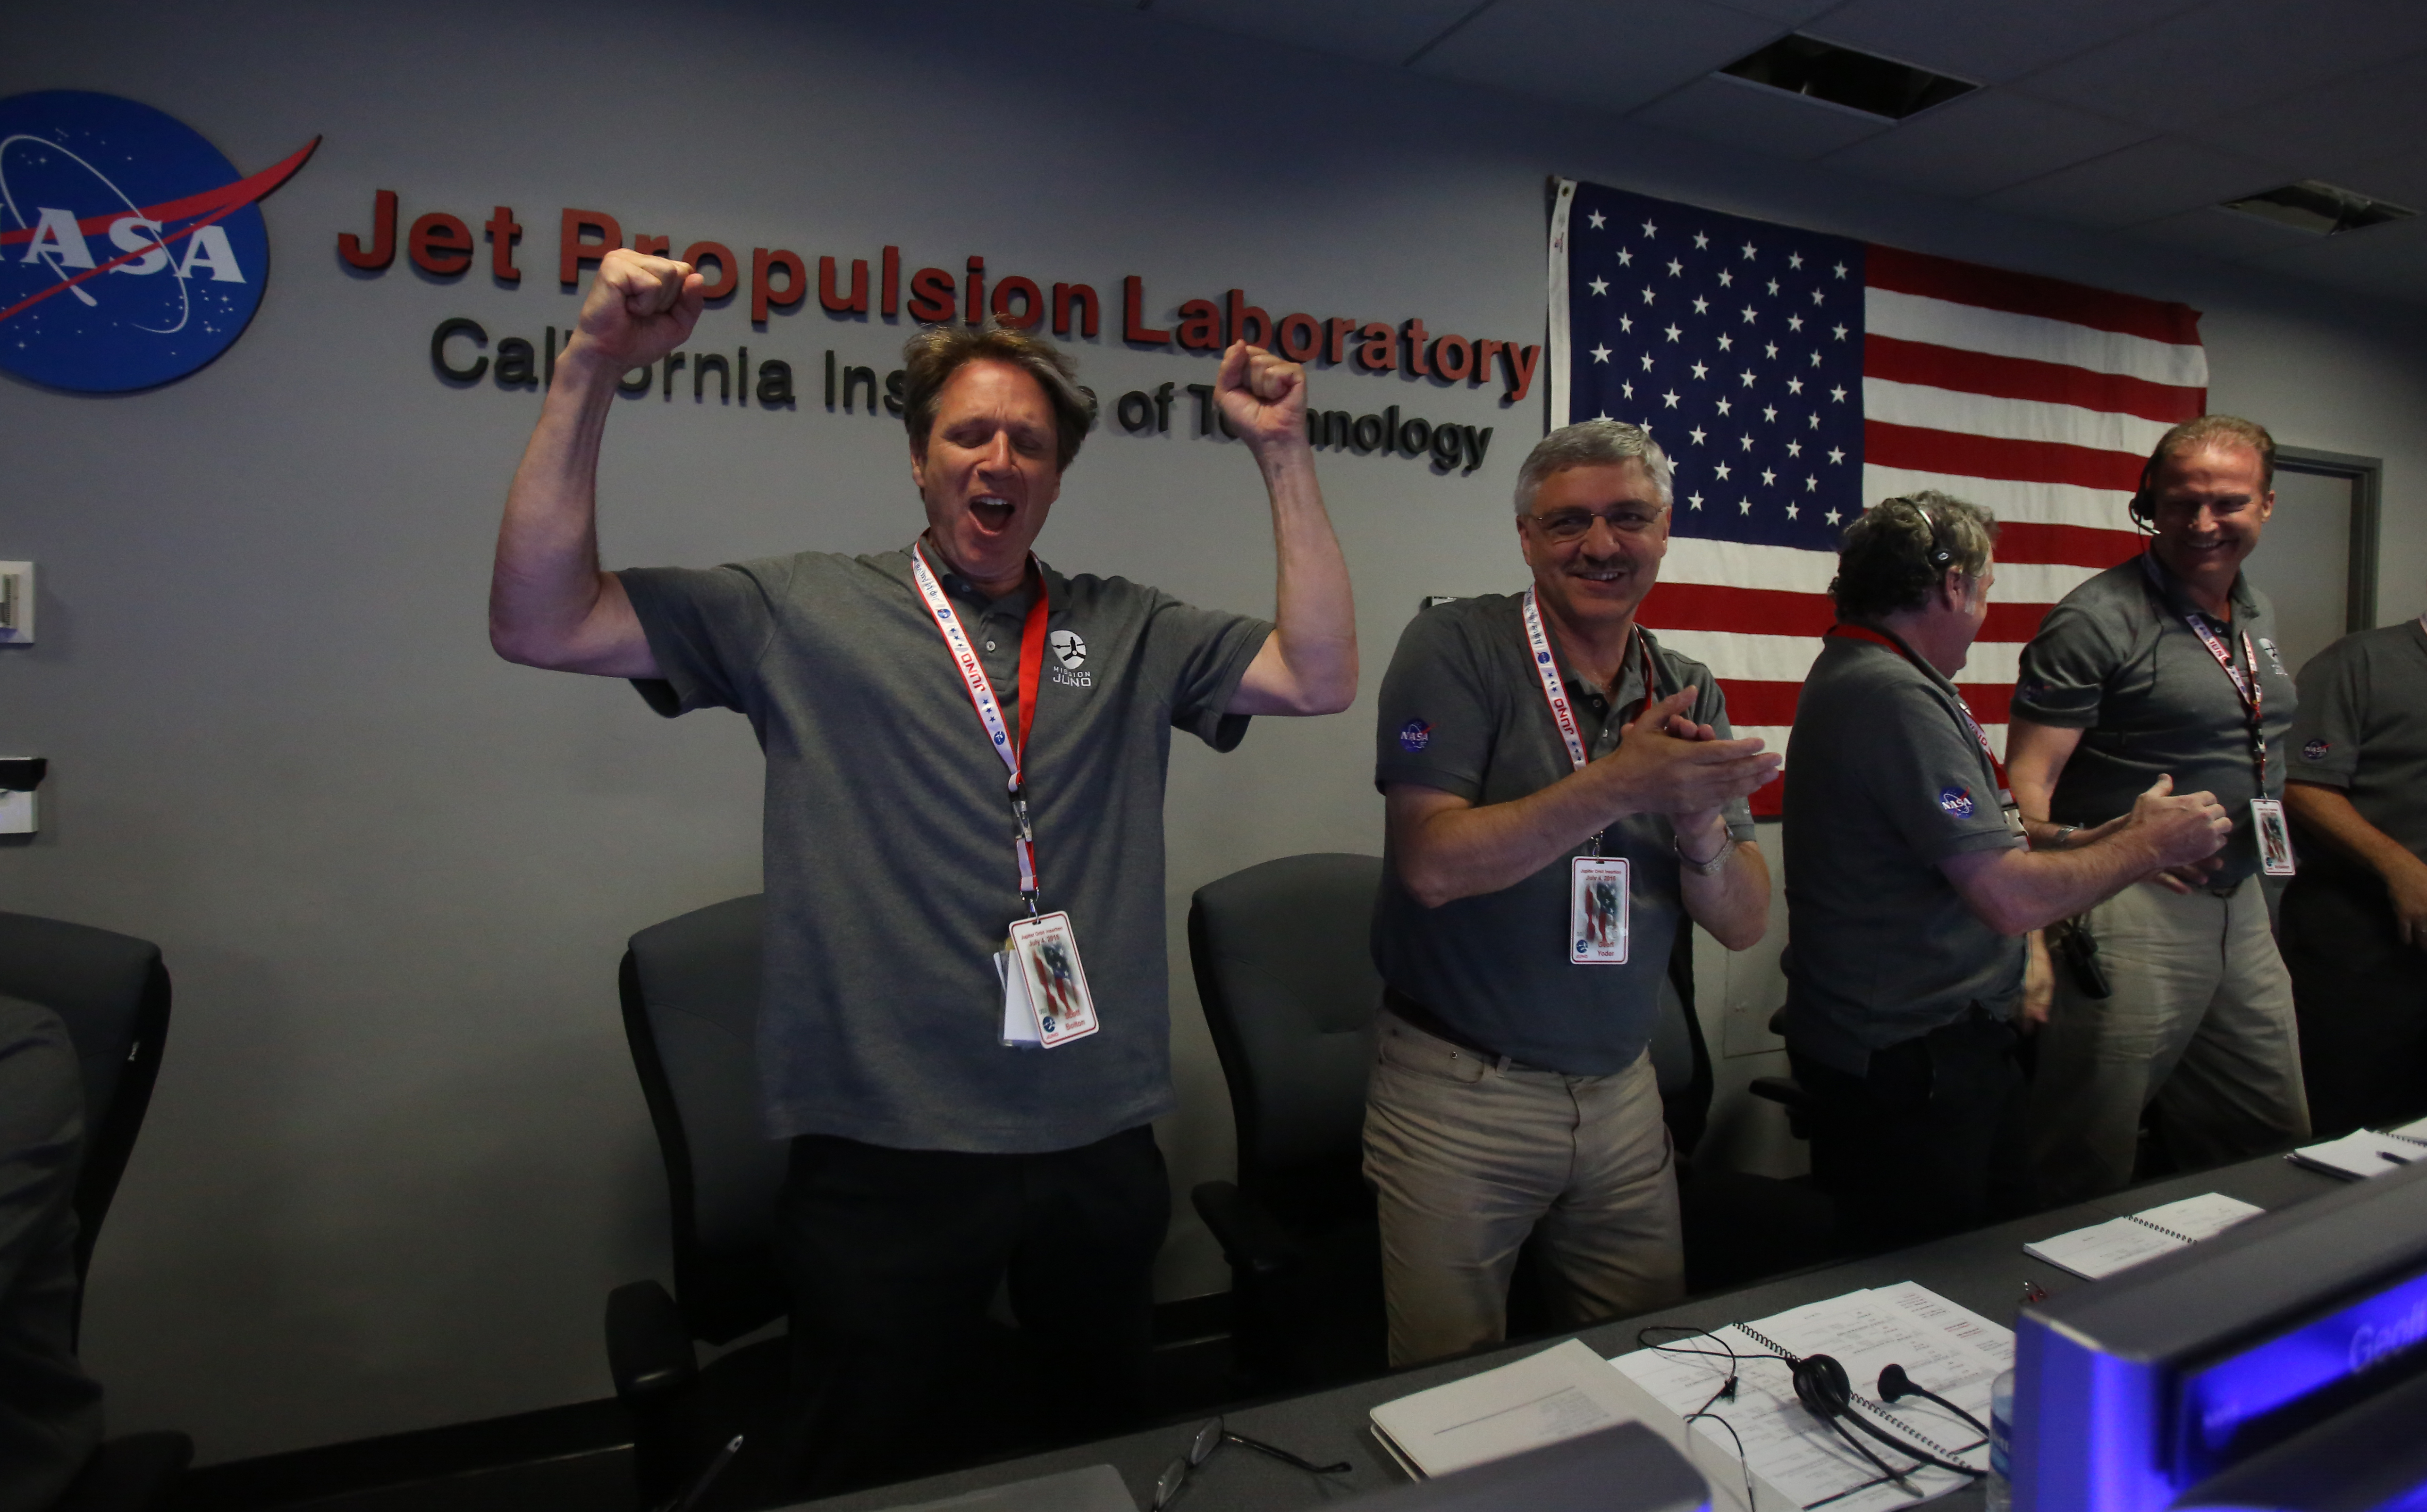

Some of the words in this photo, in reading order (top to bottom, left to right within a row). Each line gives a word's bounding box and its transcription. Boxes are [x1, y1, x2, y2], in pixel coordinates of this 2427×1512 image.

[0, 203, 246, 283] ASA
[338, 190, 522, 280] Jet
[1122, 275, 1542, 404] Laboratory
[1117, 381, 1175, 433] of
[1187, 383, 1494, 471] Tnology
[961, 653, 986, 691] JUNO
[1053, 666, 1090, 678] MISSION
[1053, 673, 1091, 687] JUNO
[1554, 698, 1574, 734] JUNO
[1400, 731, 1428, 741] NASA
[1941, 797, 1972, 810] NASA
